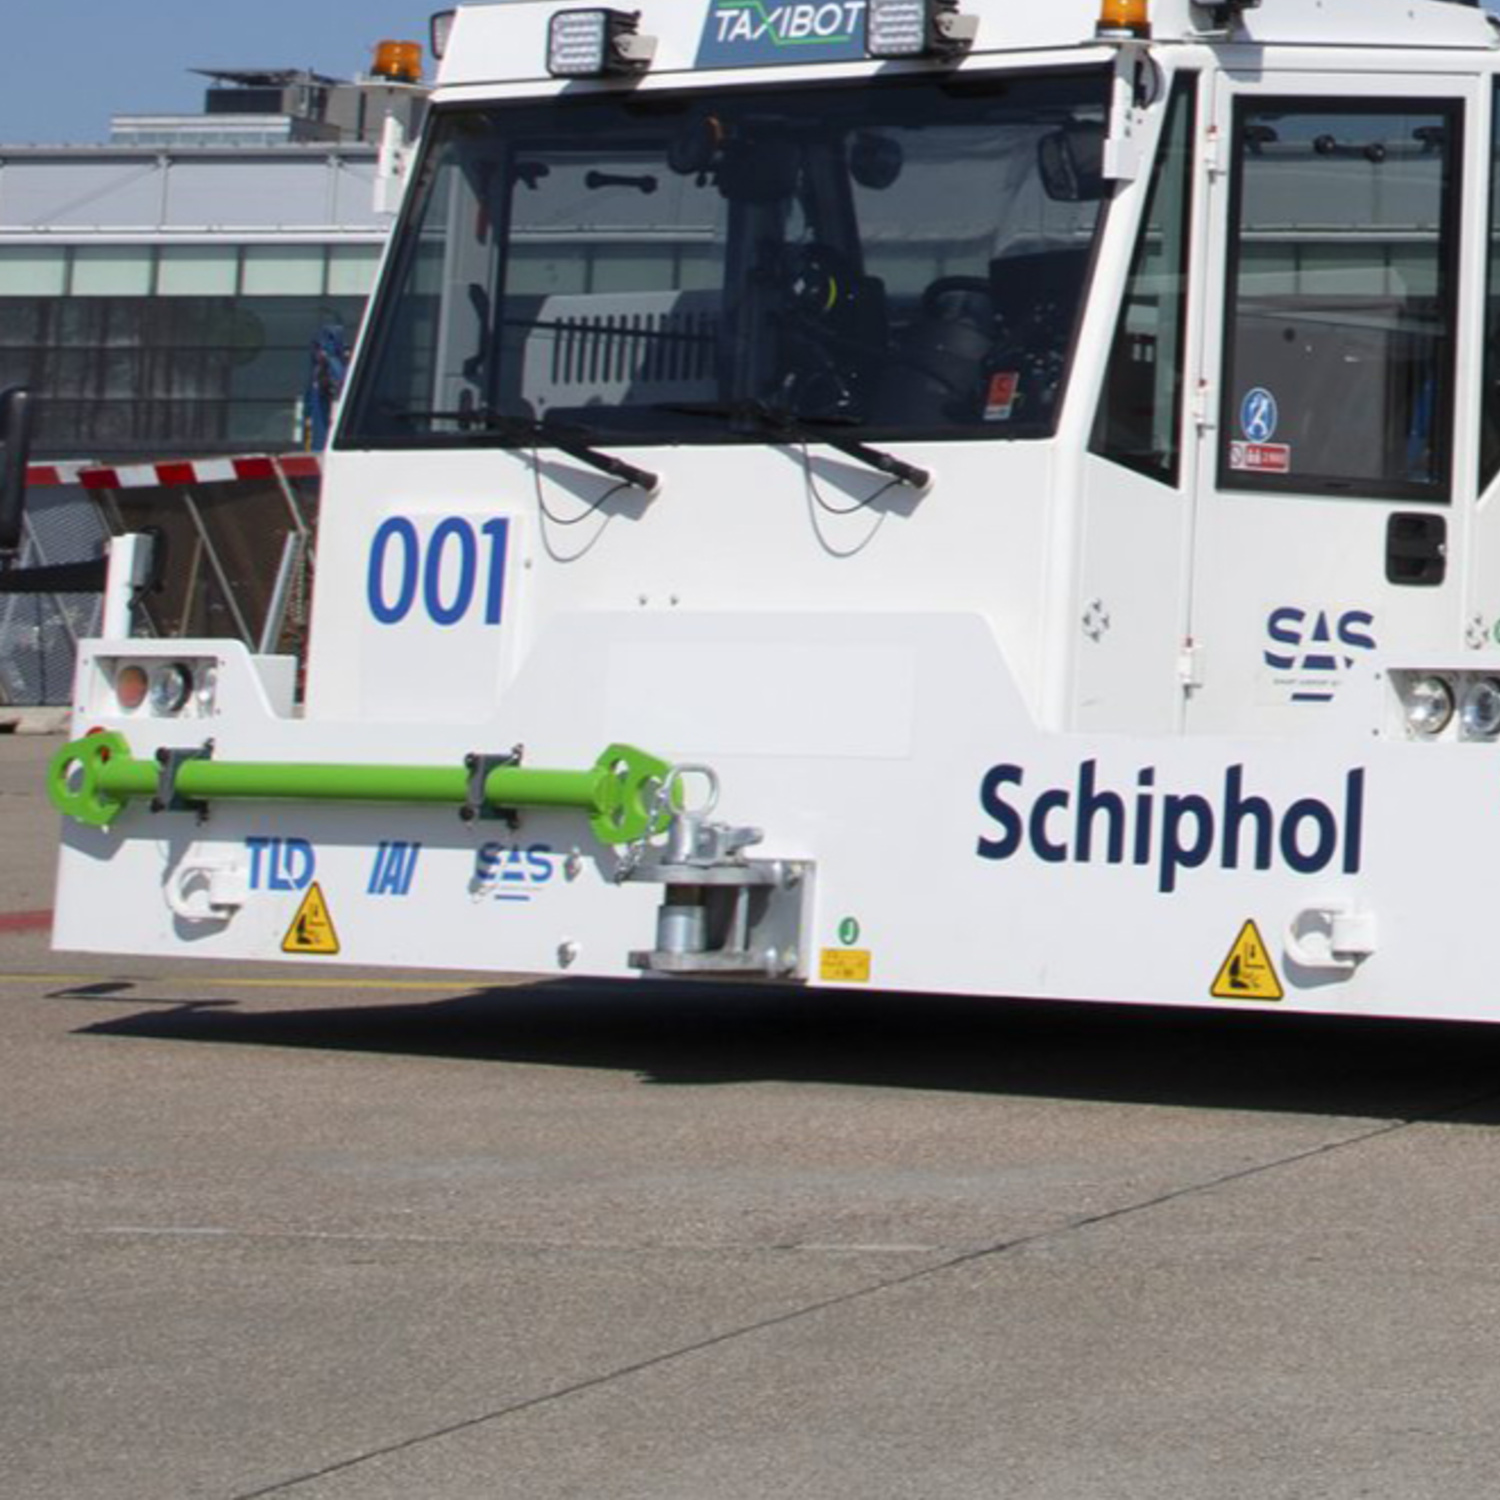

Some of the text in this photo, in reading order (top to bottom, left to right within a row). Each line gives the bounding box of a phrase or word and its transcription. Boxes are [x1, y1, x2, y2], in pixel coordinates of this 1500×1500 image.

[715, 0, 867, 46] TAXIBOT
[367, 516, 509, 626] 001
[1263, 606, 1377, 671] SAS
[976, 758, 1364, 893] Schiphol
[246, 837, 316, 890] TLD
[477, 842, 554, 882] SAS
